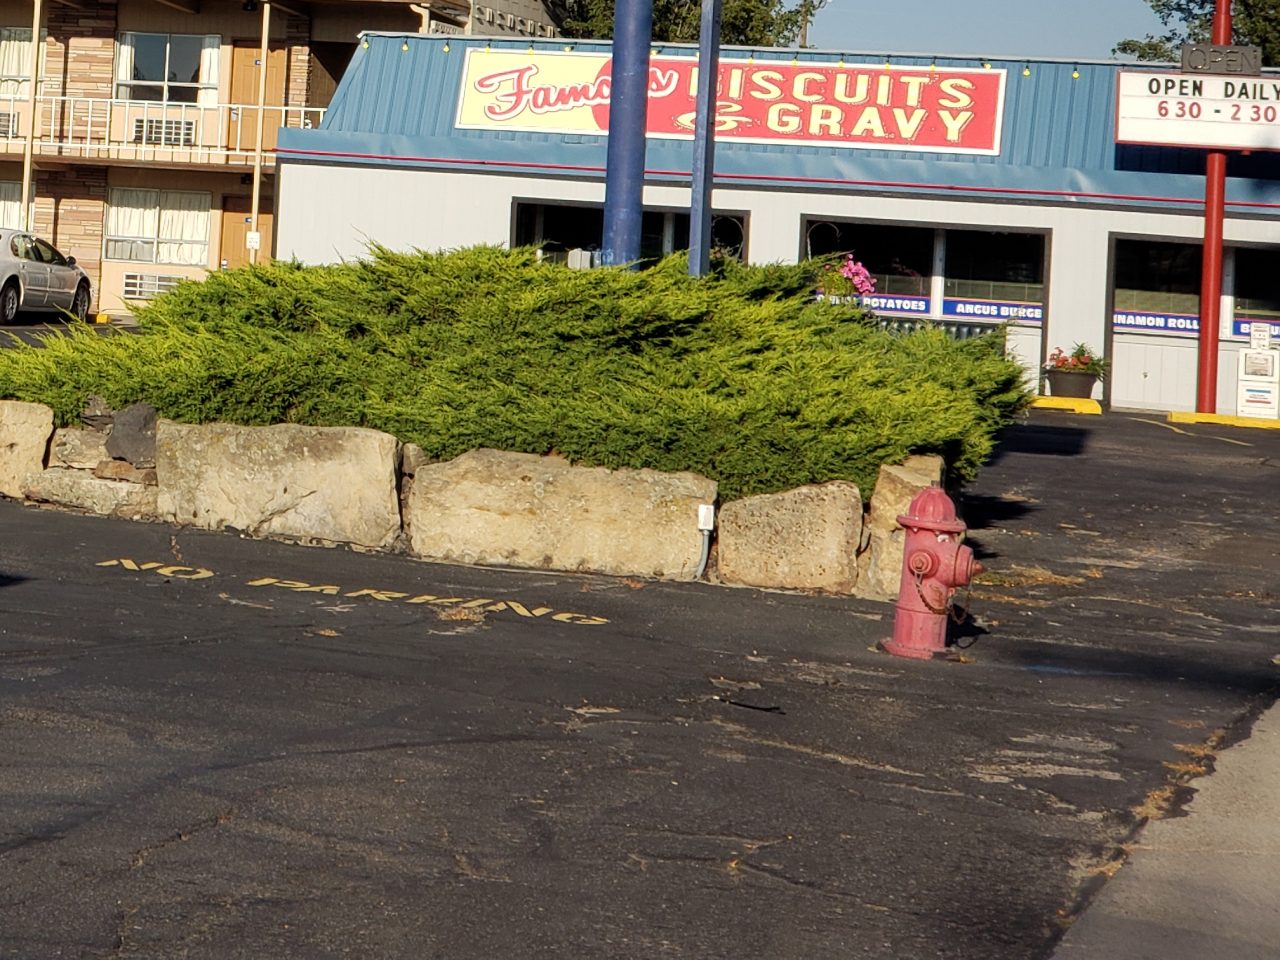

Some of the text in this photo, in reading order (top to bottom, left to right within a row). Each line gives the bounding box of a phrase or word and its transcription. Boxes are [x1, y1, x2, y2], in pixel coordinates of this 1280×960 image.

[1188, 47, 1259, 73] OPEN
[1148, 77, 1280, 101] OPEN DAILY
[766, 102, 976, 143] GRAVY
[863, 297, 926, 311] POTATOES
[956, 303, 998, 316] ANGUS
[95, 558, 612, 625] NO PARKING
